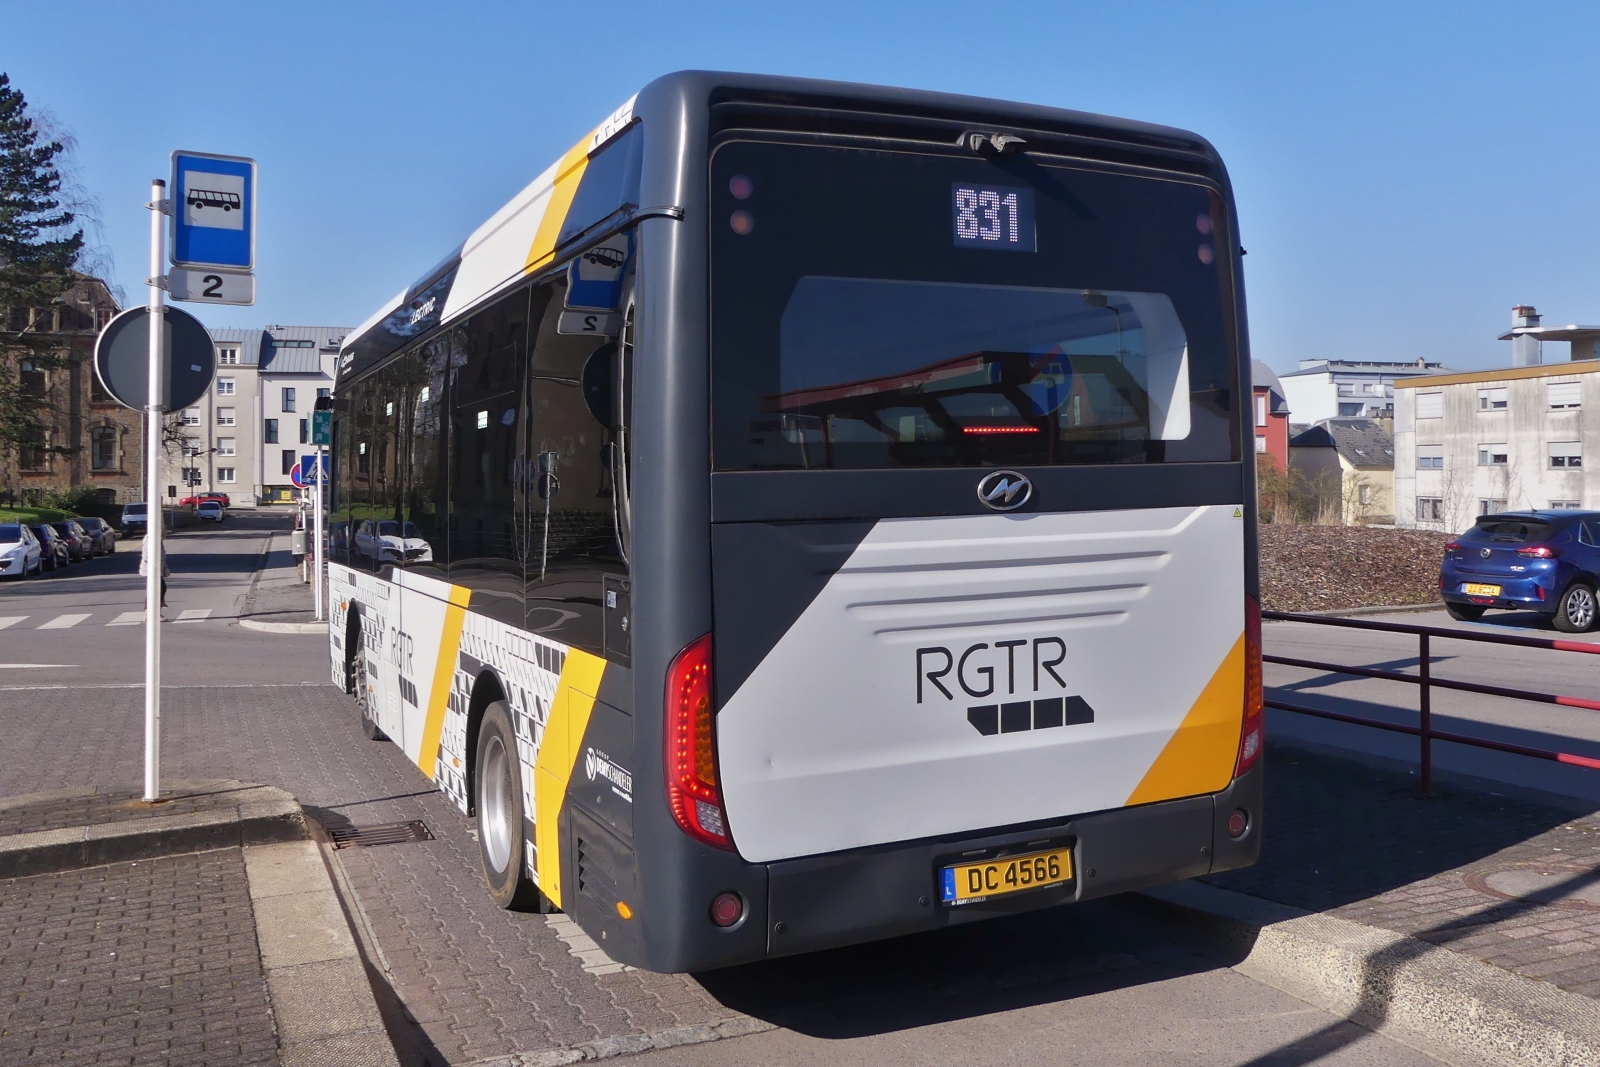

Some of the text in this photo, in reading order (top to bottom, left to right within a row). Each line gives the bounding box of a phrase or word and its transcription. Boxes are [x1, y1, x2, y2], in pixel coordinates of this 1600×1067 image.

[956, 188, 1018, 242] 831
[202, 274, 223, 298] 2
[390, 626, 414, 677] RGTR
[916, 636, 1067, 704] RGTR
[946, 886, 952, 896] L
[967, 854, 1060, 894] DC 4566
